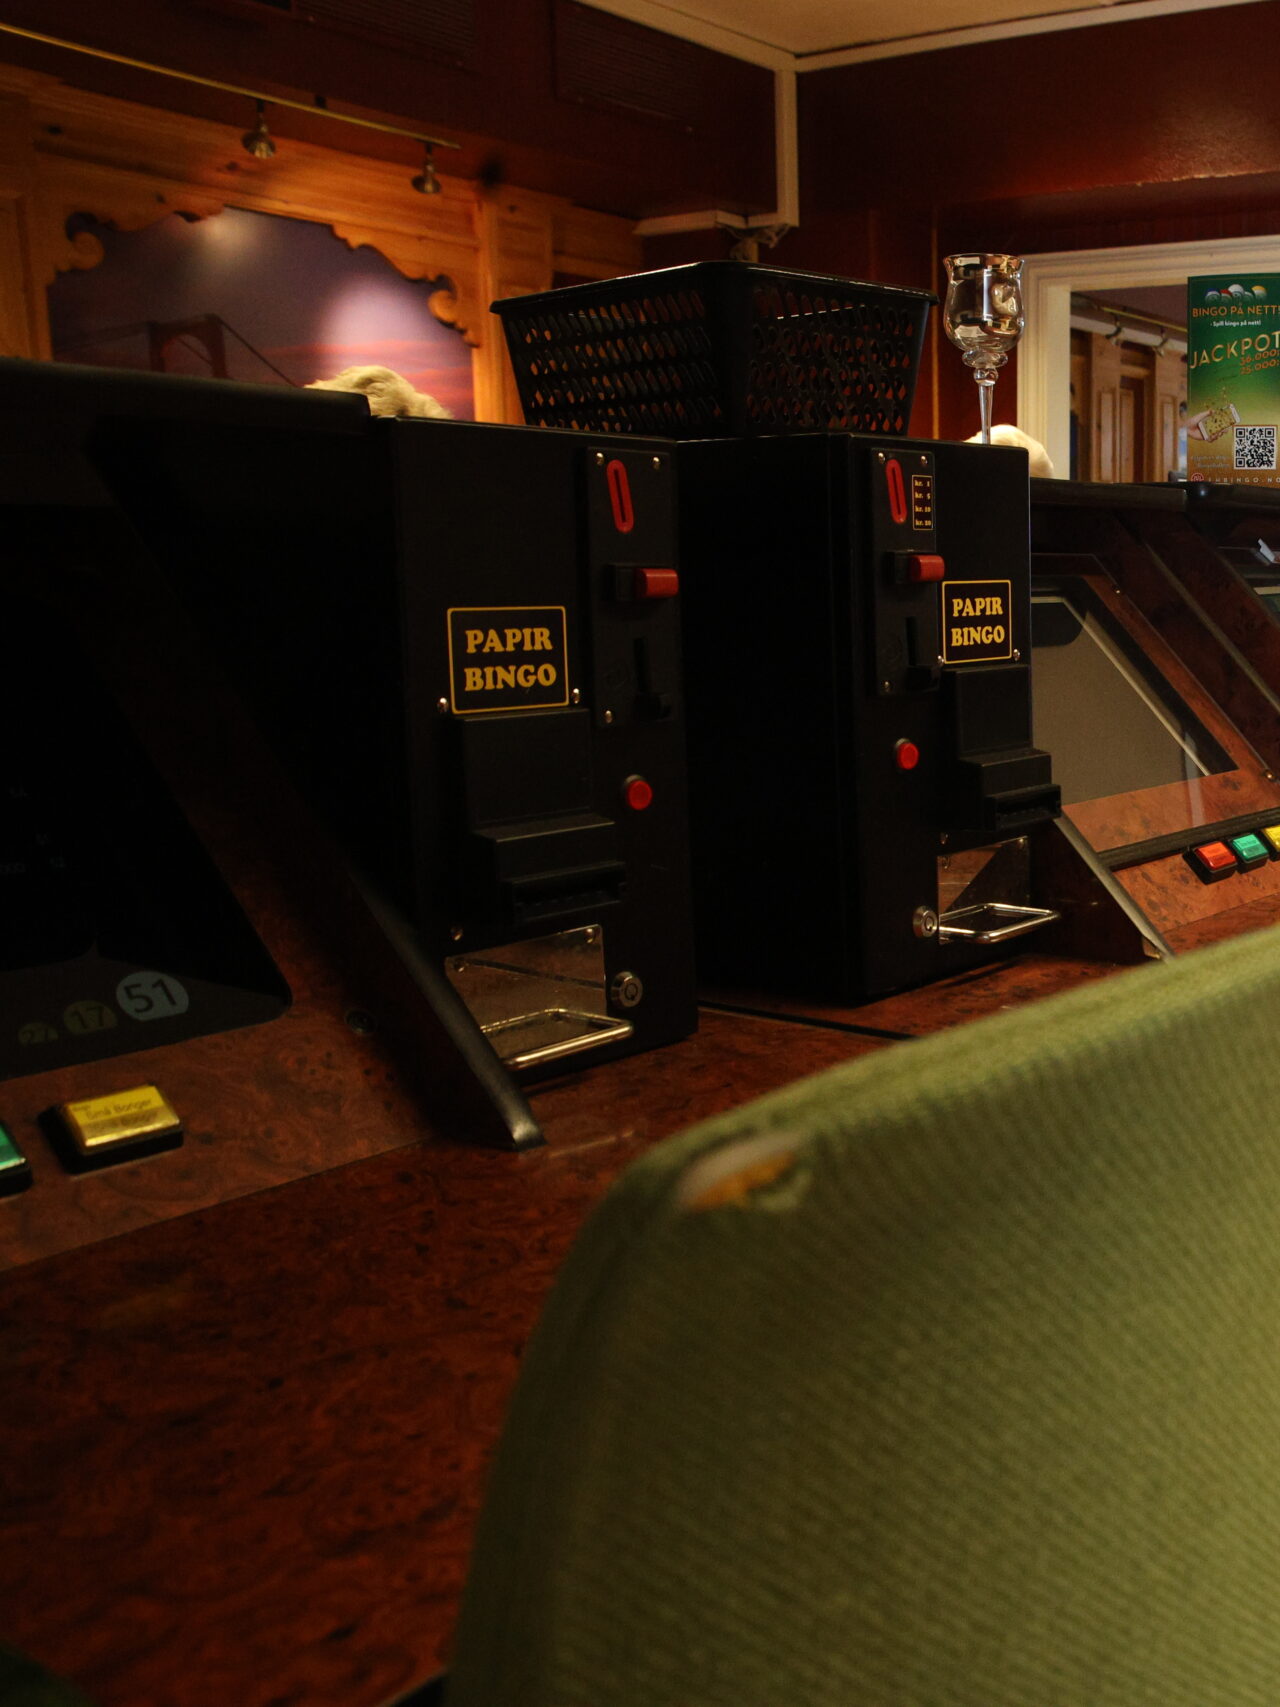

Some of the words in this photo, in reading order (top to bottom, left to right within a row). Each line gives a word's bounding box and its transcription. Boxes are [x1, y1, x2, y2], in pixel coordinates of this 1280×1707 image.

[1192, 306, 1228, 318] BINGO
[1230, 303, 1244, 315] PÅ
[1247, 305, 1280, 316] NETT!
[952, 597, 1004, 617] PAPIR
[465, 627, 553, 654] PAPIR
[951, 626, 1005, 647] BINGO
[464, 664, 557, 692] BINGO
[123, 978, 177, 1014] 51
[72, 1006, 106, 1030] 17
